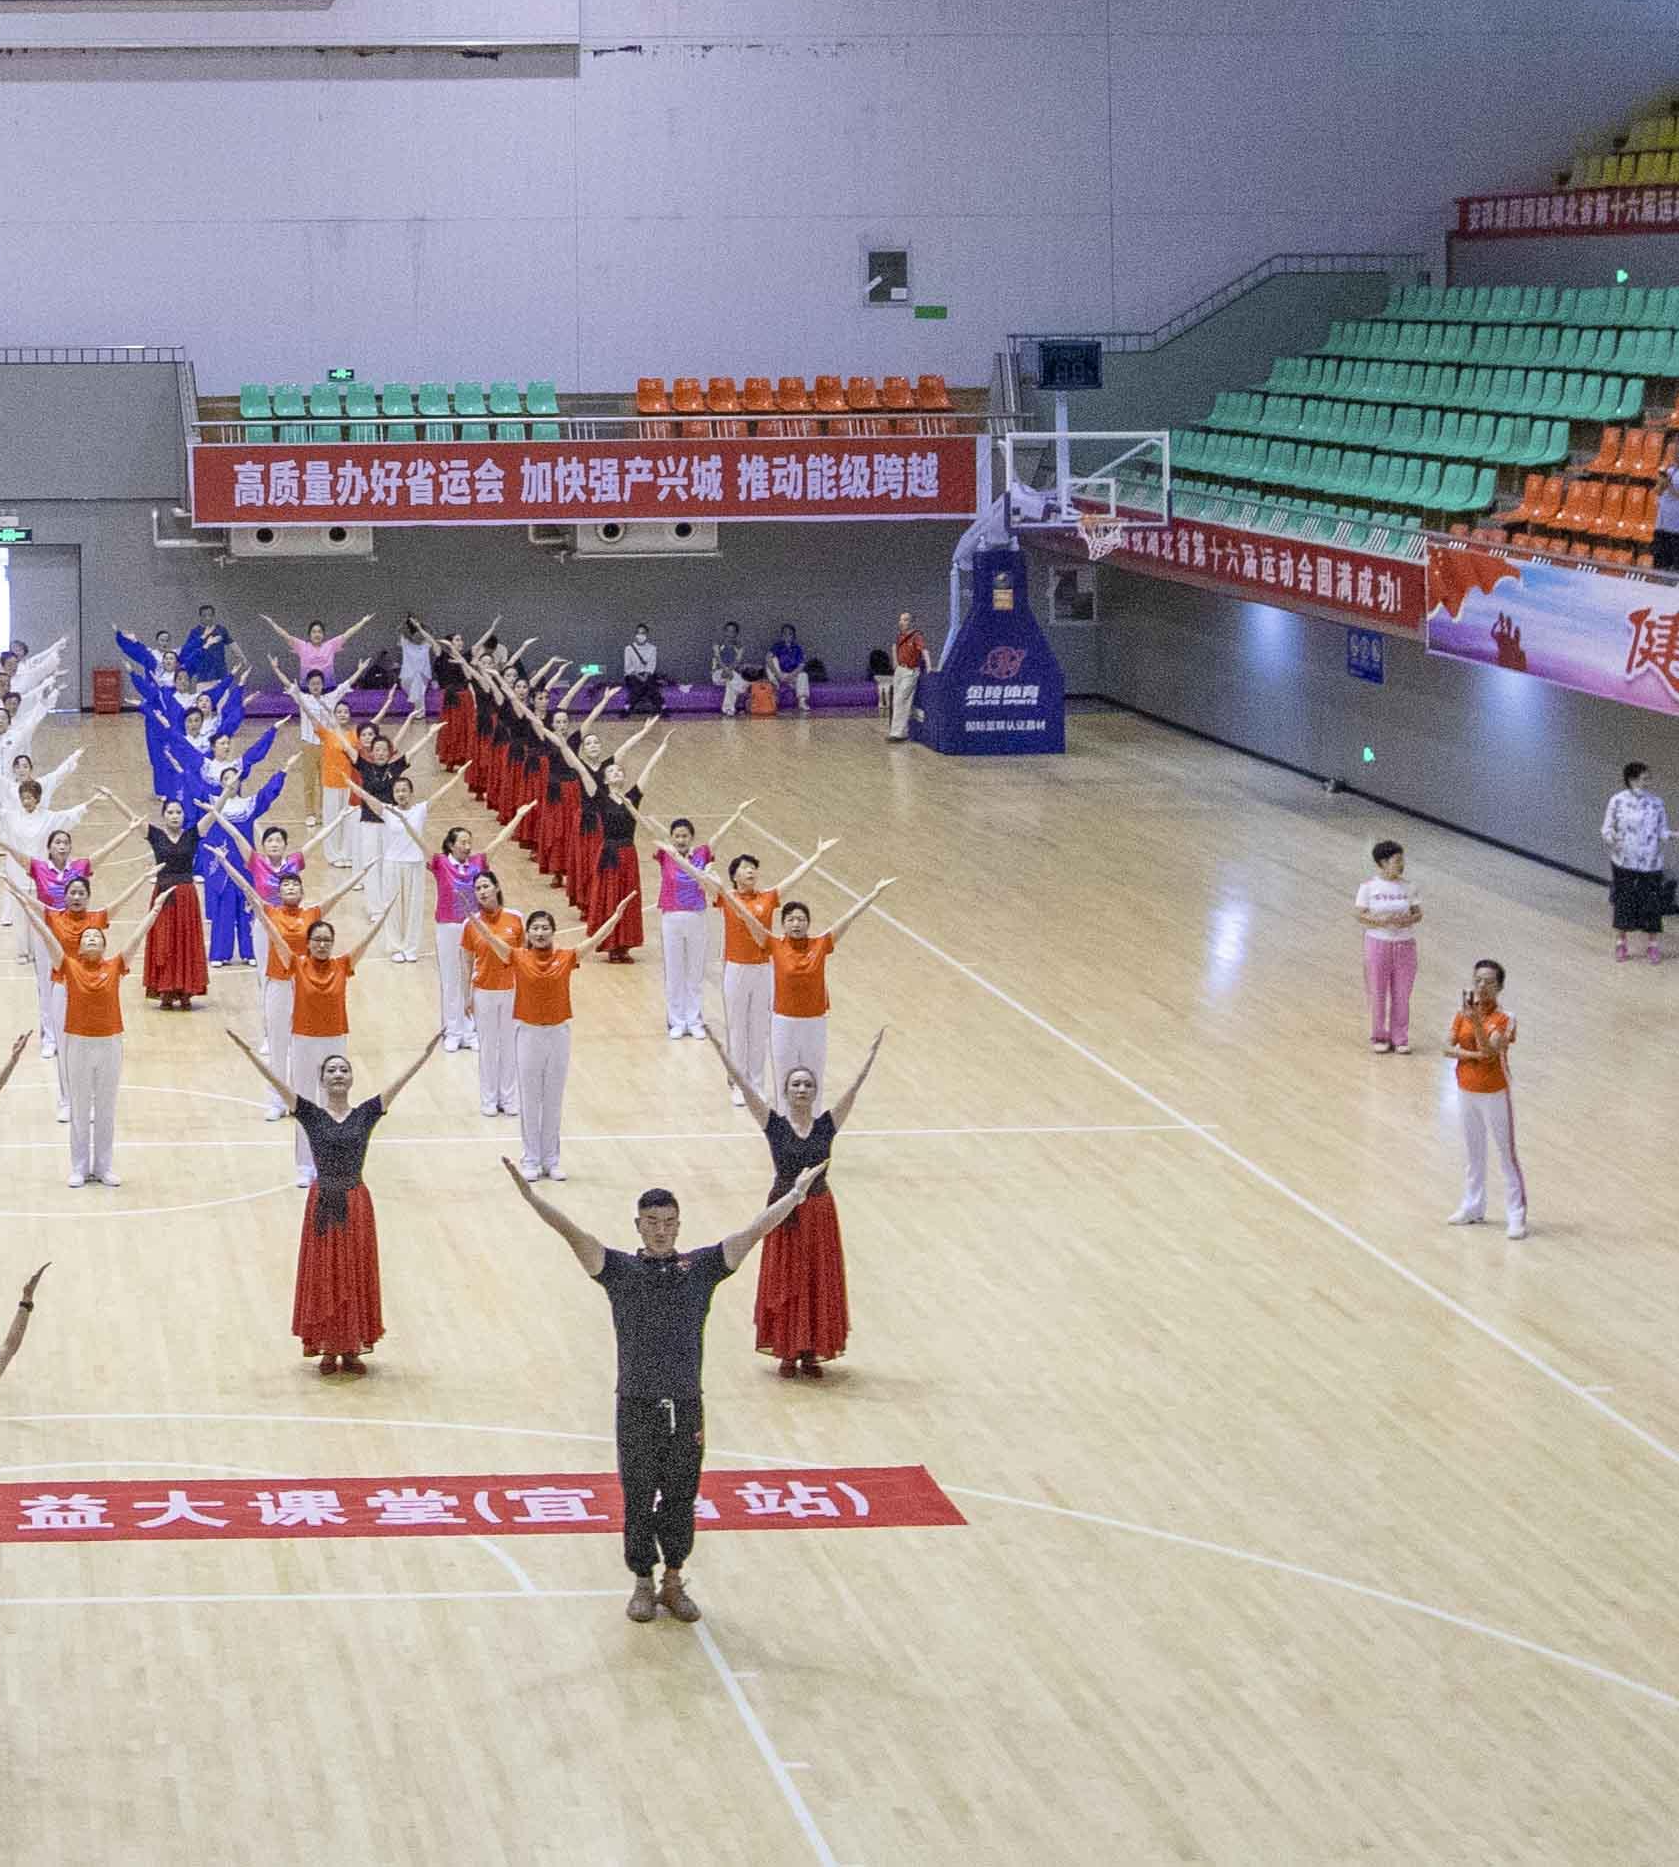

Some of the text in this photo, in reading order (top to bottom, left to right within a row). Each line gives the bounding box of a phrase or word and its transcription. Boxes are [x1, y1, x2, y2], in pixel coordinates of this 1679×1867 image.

[233, 454, 940, 507] 高质量办好省运会 加快强产兴城 推动能级跨越
